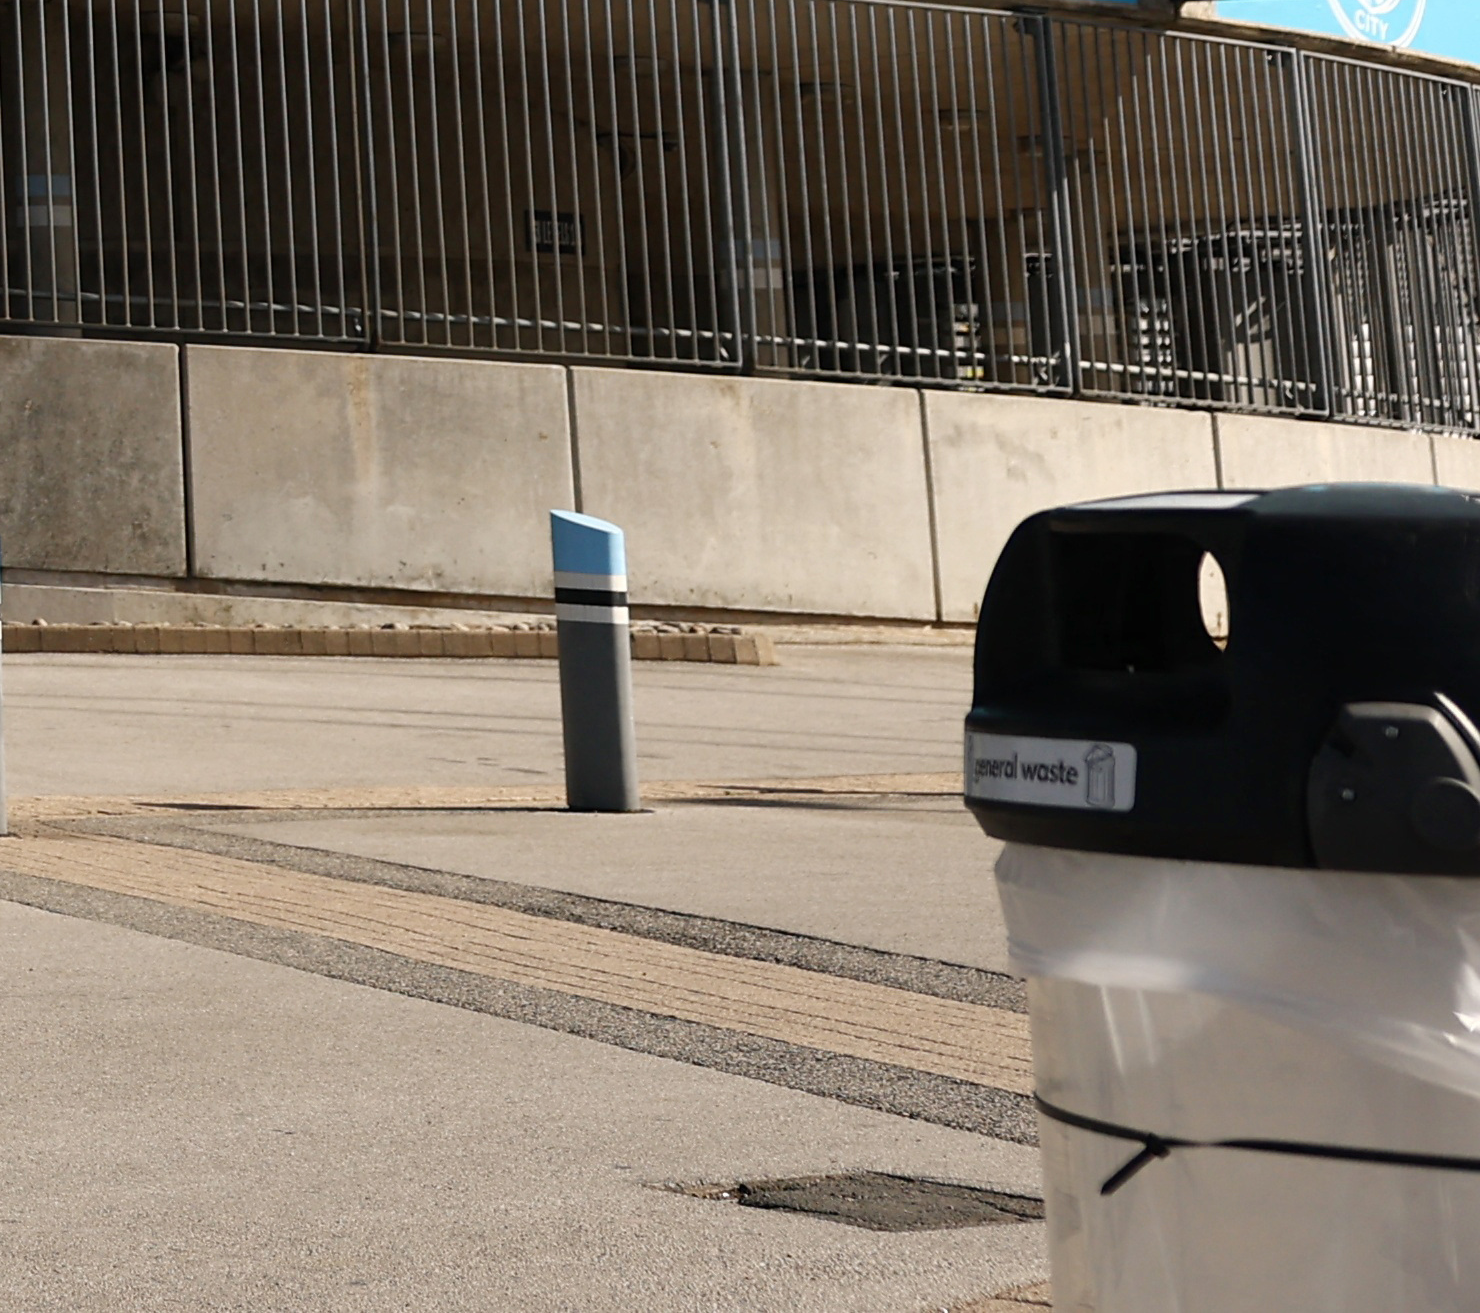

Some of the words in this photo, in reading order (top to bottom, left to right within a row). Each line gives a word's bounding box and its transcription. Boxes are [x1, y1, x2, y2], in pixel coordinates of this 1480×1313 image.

[1355, 9, 1390, 41] CITY
[974, 752, 1018, 784] general
[1020, 760, 1079, 785] waste
